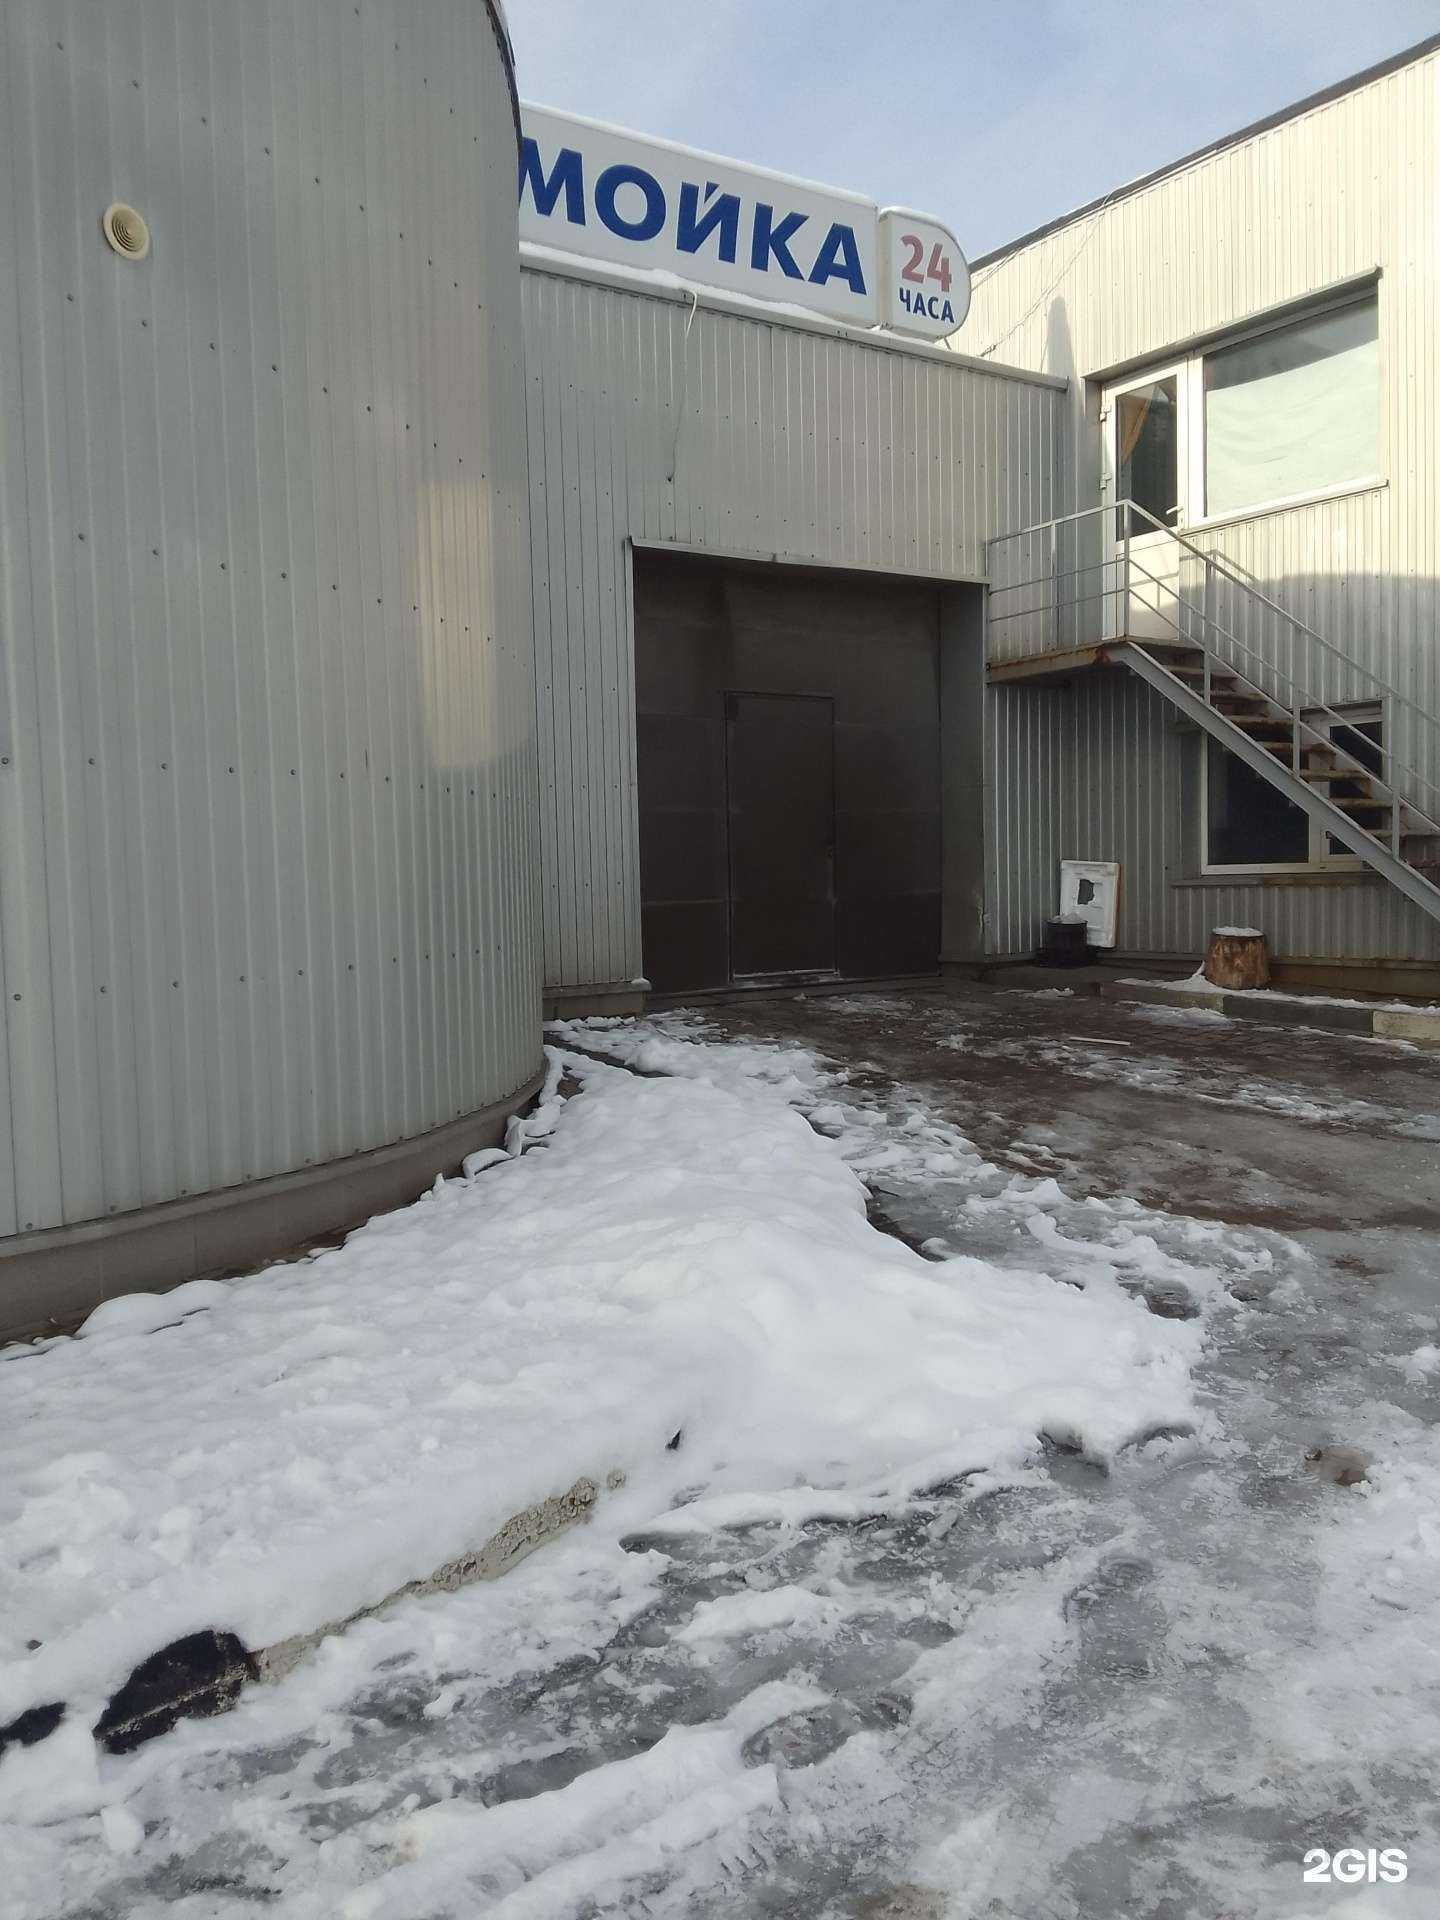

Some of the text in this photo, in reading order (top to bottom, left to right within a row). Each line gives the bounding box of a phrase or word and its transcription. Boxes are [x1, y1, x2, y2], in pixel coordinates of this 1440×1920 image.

[519, 137, 867, 295] МОЙКА
[901, 234, 952, 292] 24
[899, 287, 955, 324] ЧАСА
